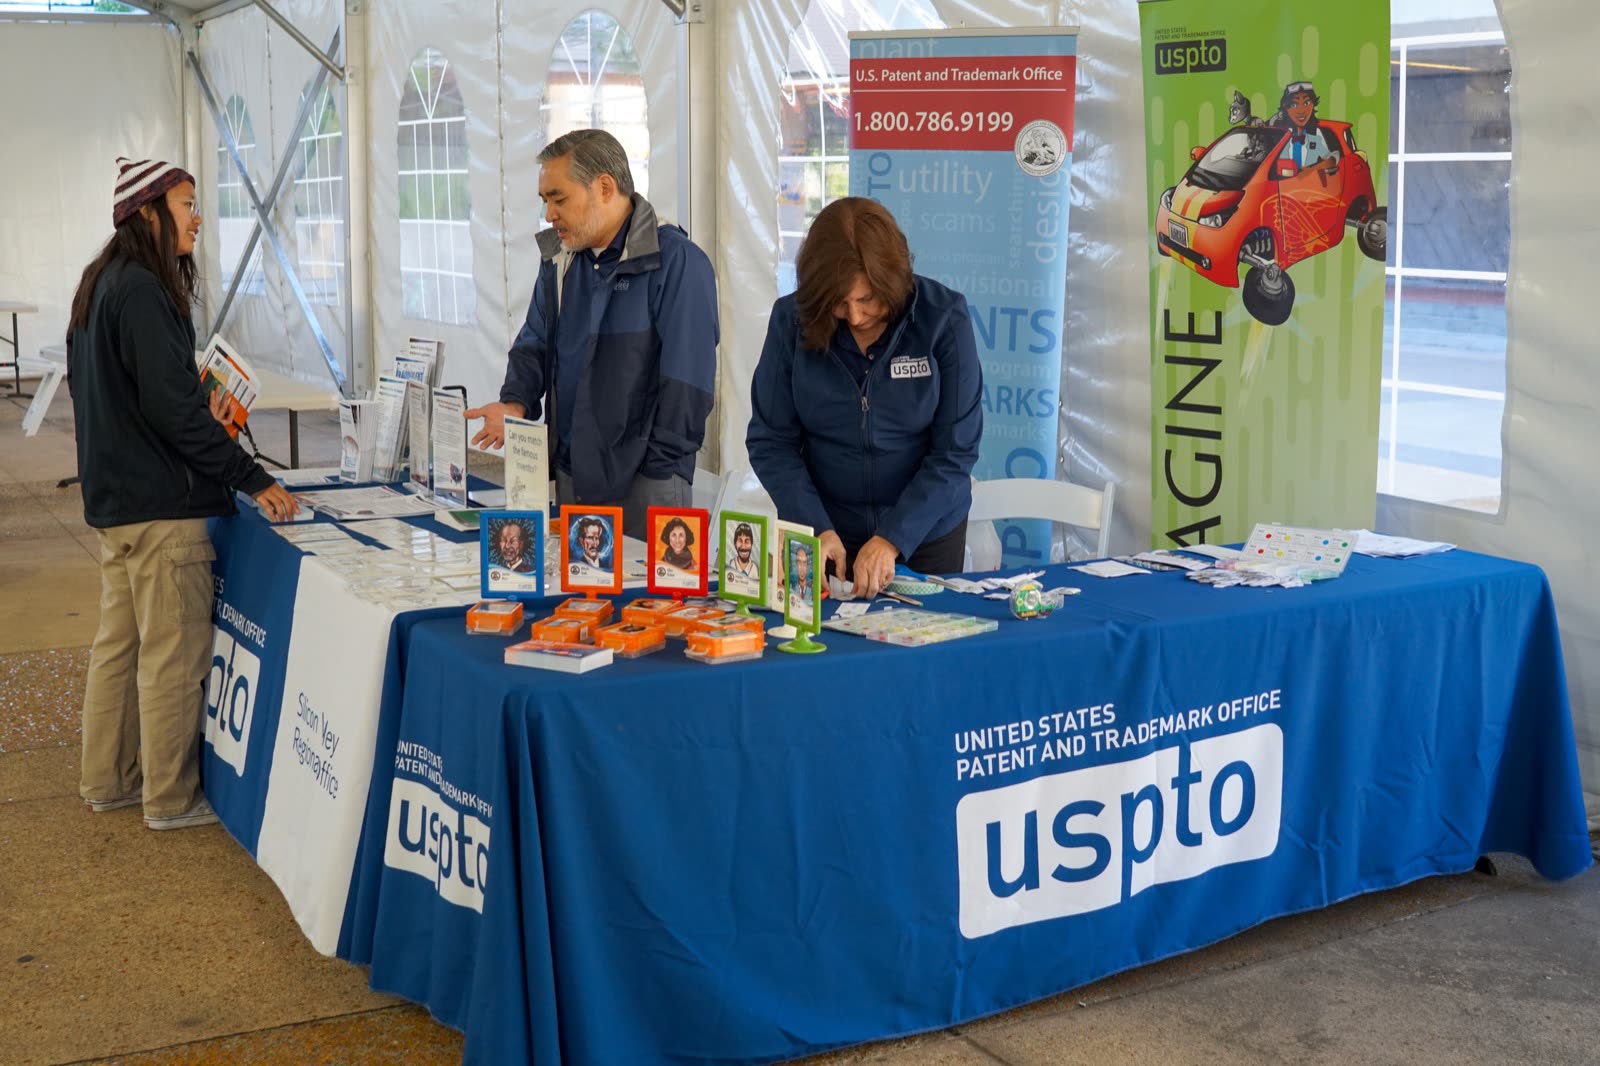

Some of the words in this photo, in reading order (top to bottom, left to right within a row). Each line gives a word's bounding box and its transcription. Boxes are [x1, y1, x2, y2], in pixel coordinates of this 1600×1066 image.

[855, 69, 879, 82] U.S.
[881, 69, 922, 82] Patent
[924, 68, 949, 81] and
[951, 67, 1020, 81] Trademark
[1023, 66, 1063, 81] Office
[1160, 40, 1221, 73] uspto
[854, 111, 1014, 132] 1.800.786.9199
[900, 159, 993, 203] utility
[919, 210, 996, 233] scams
[893, 361, 928, 379] uspto
[1164, 308, 1223, 548] AGINE
[245, 620, 267, 648] OFFICE
[297, 692, 319, 734] Silicon
[954, 719, 1034, 754] UNITED
[1038, 702, 1116, 737] STATES
[956, 743, 1037, 781] PATENT
[1040, 734, 1086, 763] AND
[1091, 704, 1213, 752] TRADEMARK
[1217, 689, 1281, 722] OFFICE
[985, 748, 1257, 902] uspto
